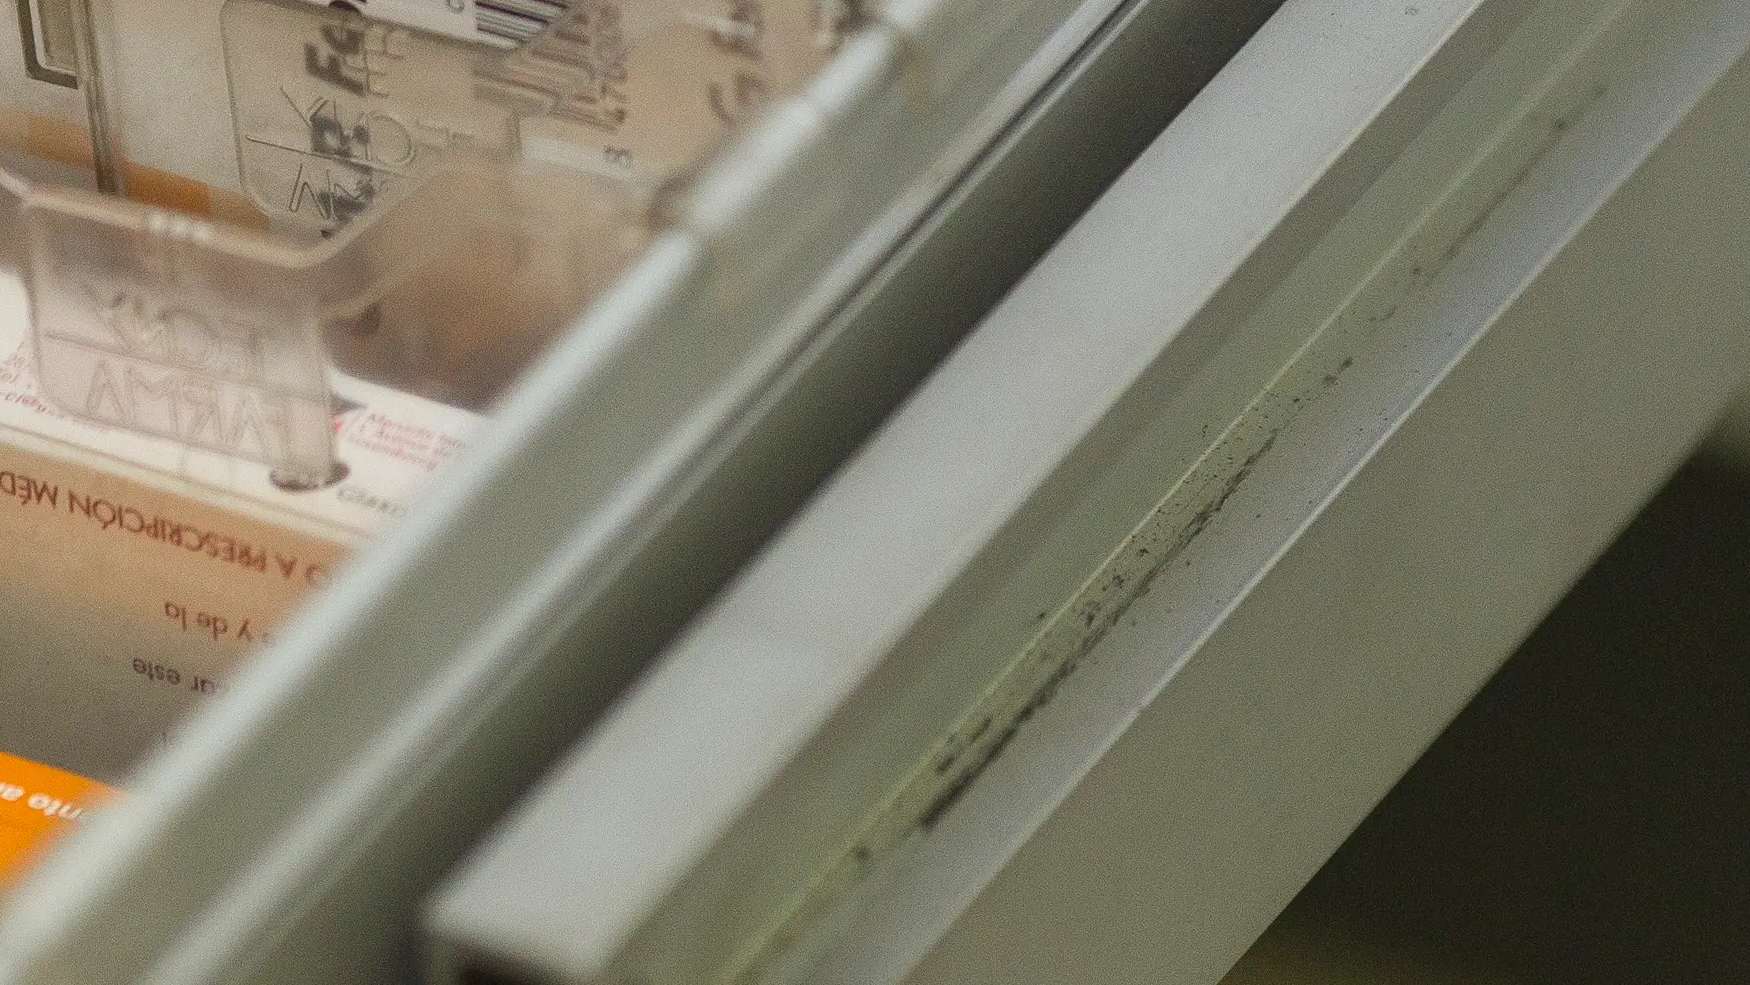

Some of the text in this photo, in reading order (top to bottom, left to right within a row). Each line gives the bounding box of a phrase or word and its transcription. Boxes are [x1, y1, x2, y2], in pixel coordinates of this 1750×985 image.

[68, 490, 268, 574] PRESCRIPCIÓN
[268, 551, 297, 584] A
[158, 600, 254, 642] y de la
[129, 656, 182, 686] este
[27, 792, 83, 821] nto
